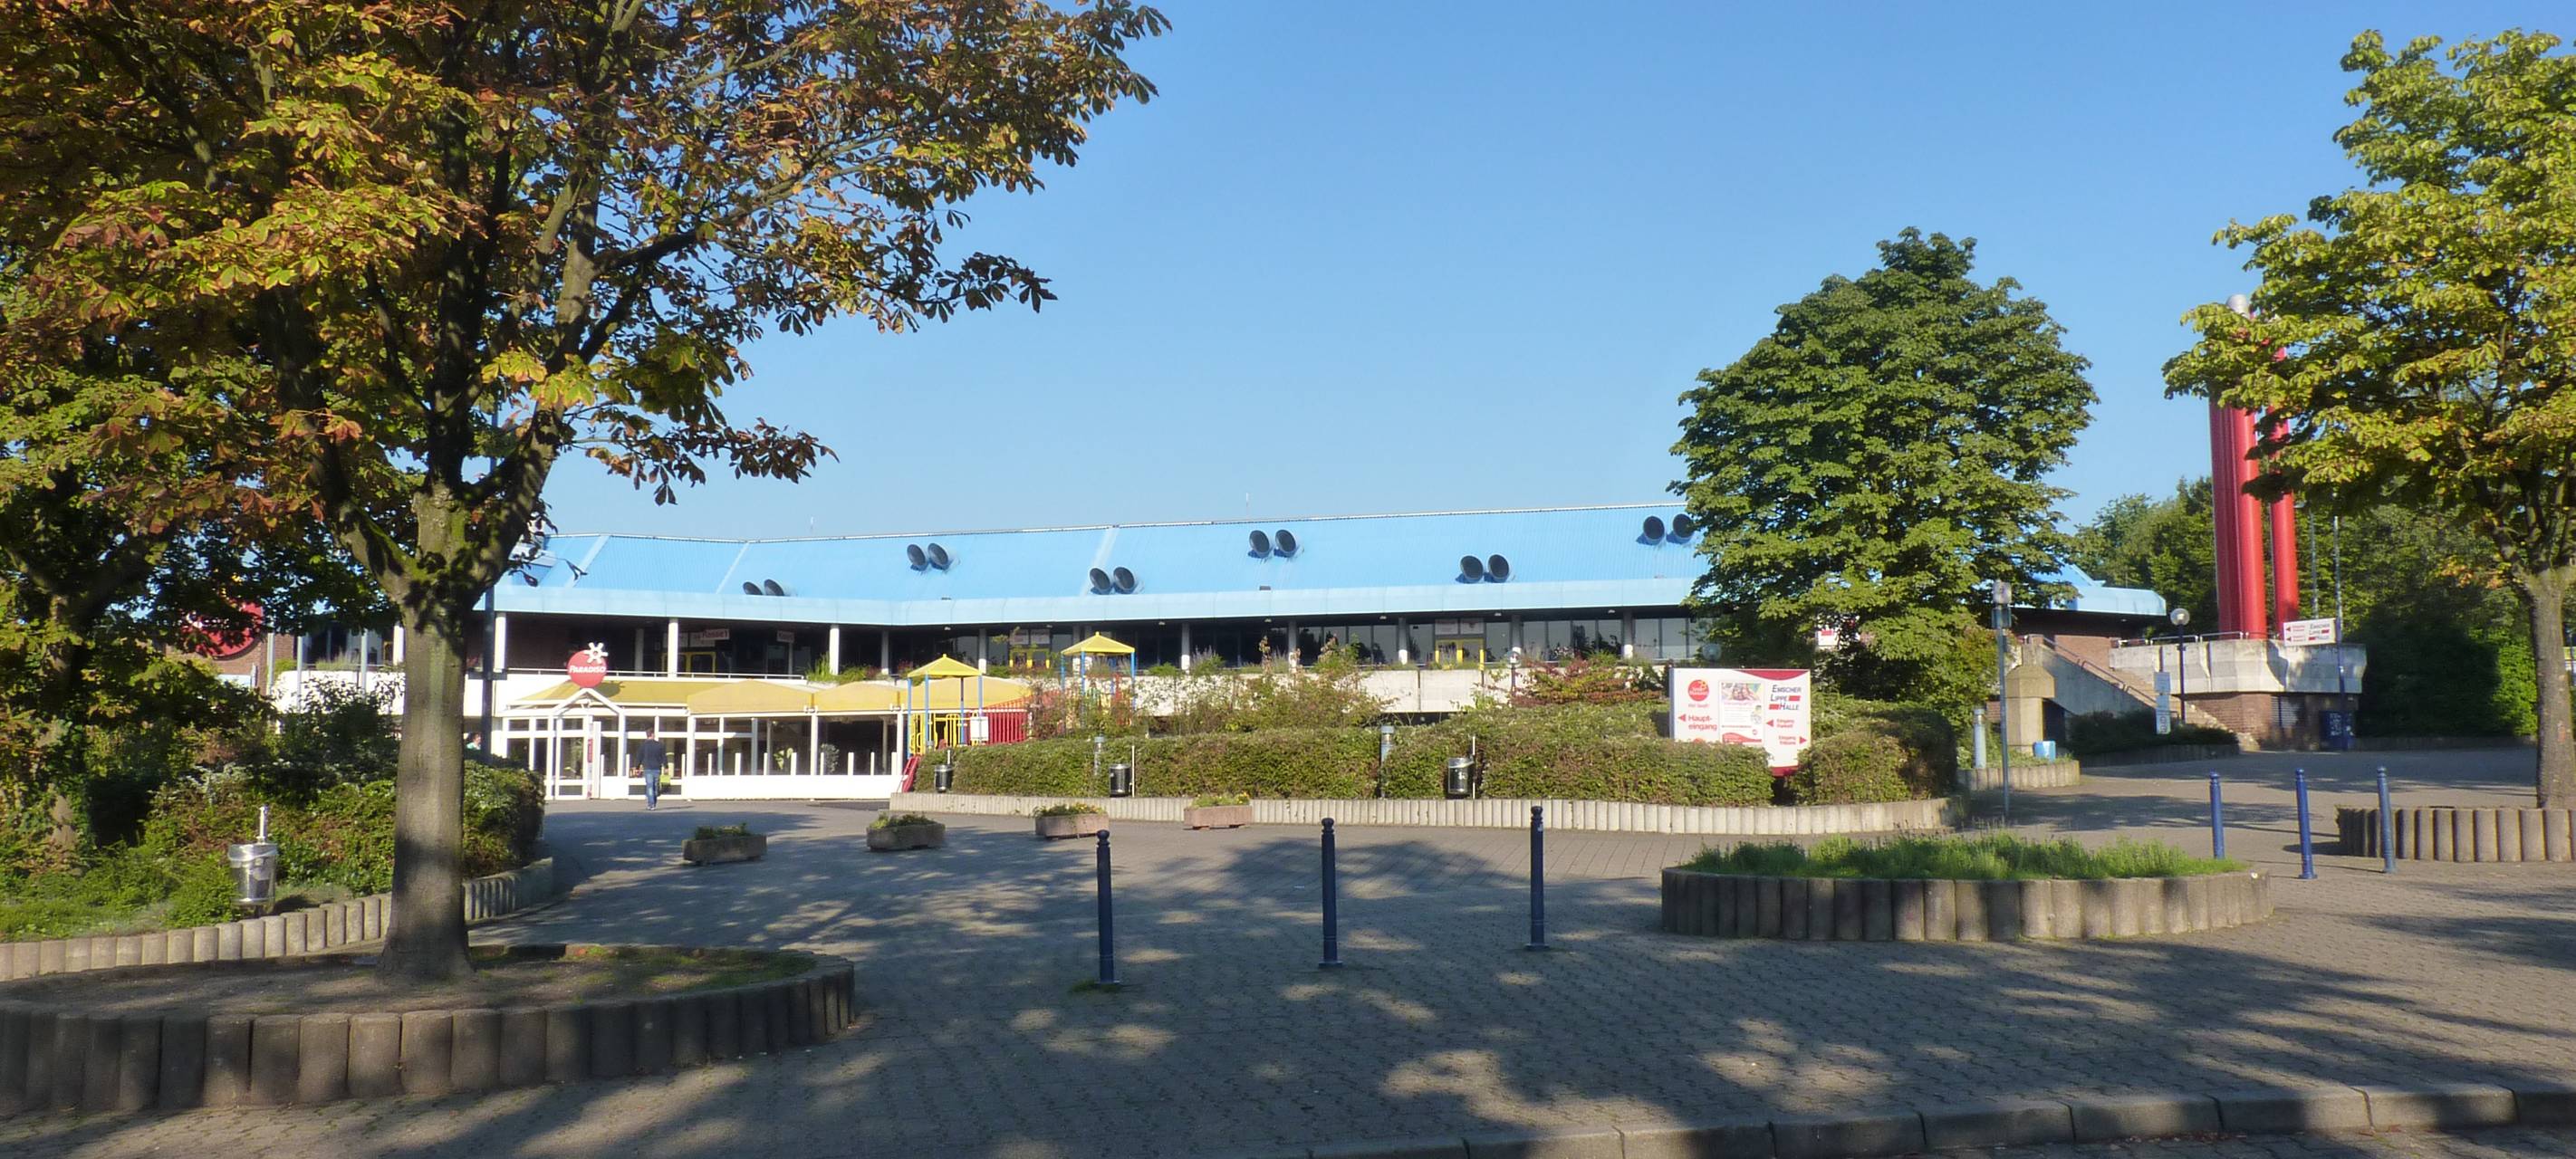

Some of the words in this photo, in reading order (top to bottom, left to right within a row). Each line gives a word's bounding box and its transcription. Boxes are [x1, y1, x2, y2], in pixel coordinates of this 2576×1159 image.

[569, 666, 607, 674] PARADISO
[1772, 685, 1802, 693] EMSCHER
[1779, 702, 1800, 710] HALLE
[1687, 723, 1717, 732] eingang
